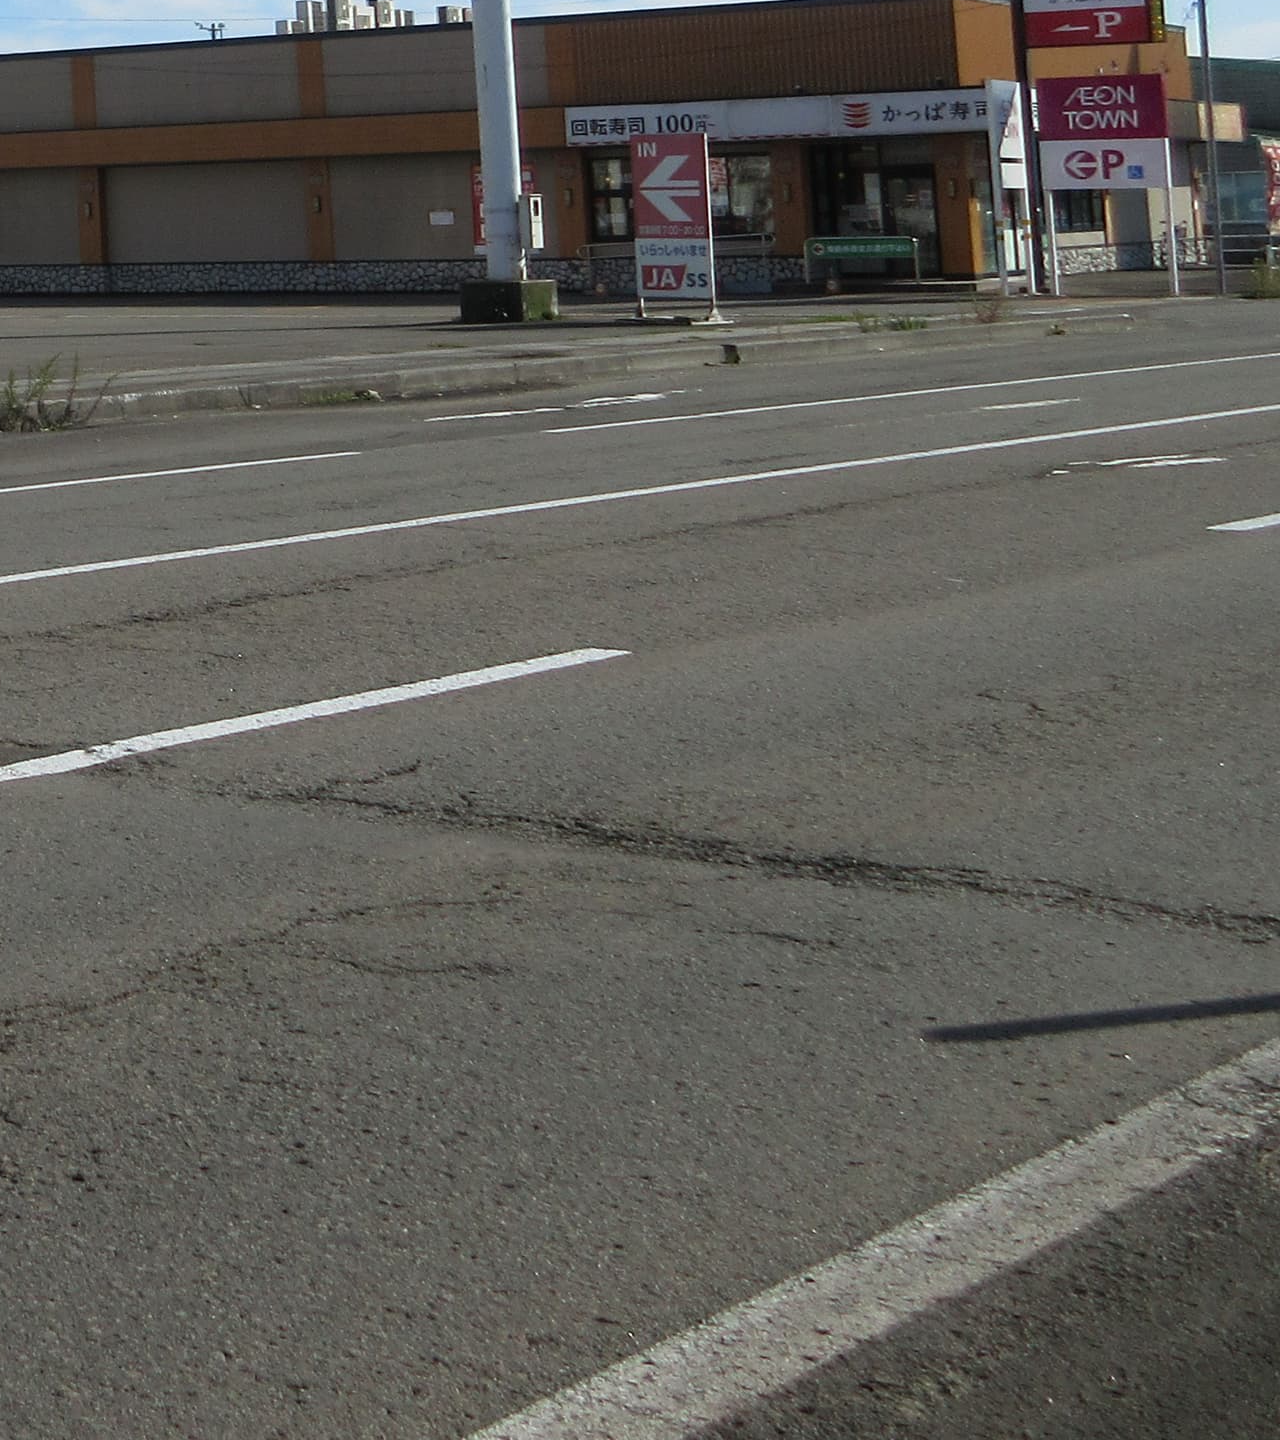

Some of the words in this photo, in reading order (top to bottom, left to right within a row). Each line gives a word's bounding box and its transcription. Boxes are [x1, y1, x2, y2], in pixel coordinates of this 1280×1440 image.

[1093, 11, 1122, 38] P
[571, 116, 646, 137] 回転寿司
[1062, 109, 1139, 130] TOWN
[637, 142, 656, 158] IN
[1101, 149, 1124, 180] P
[646, 268, 677, 288] JA
[686, 273, 708, 288] SS
